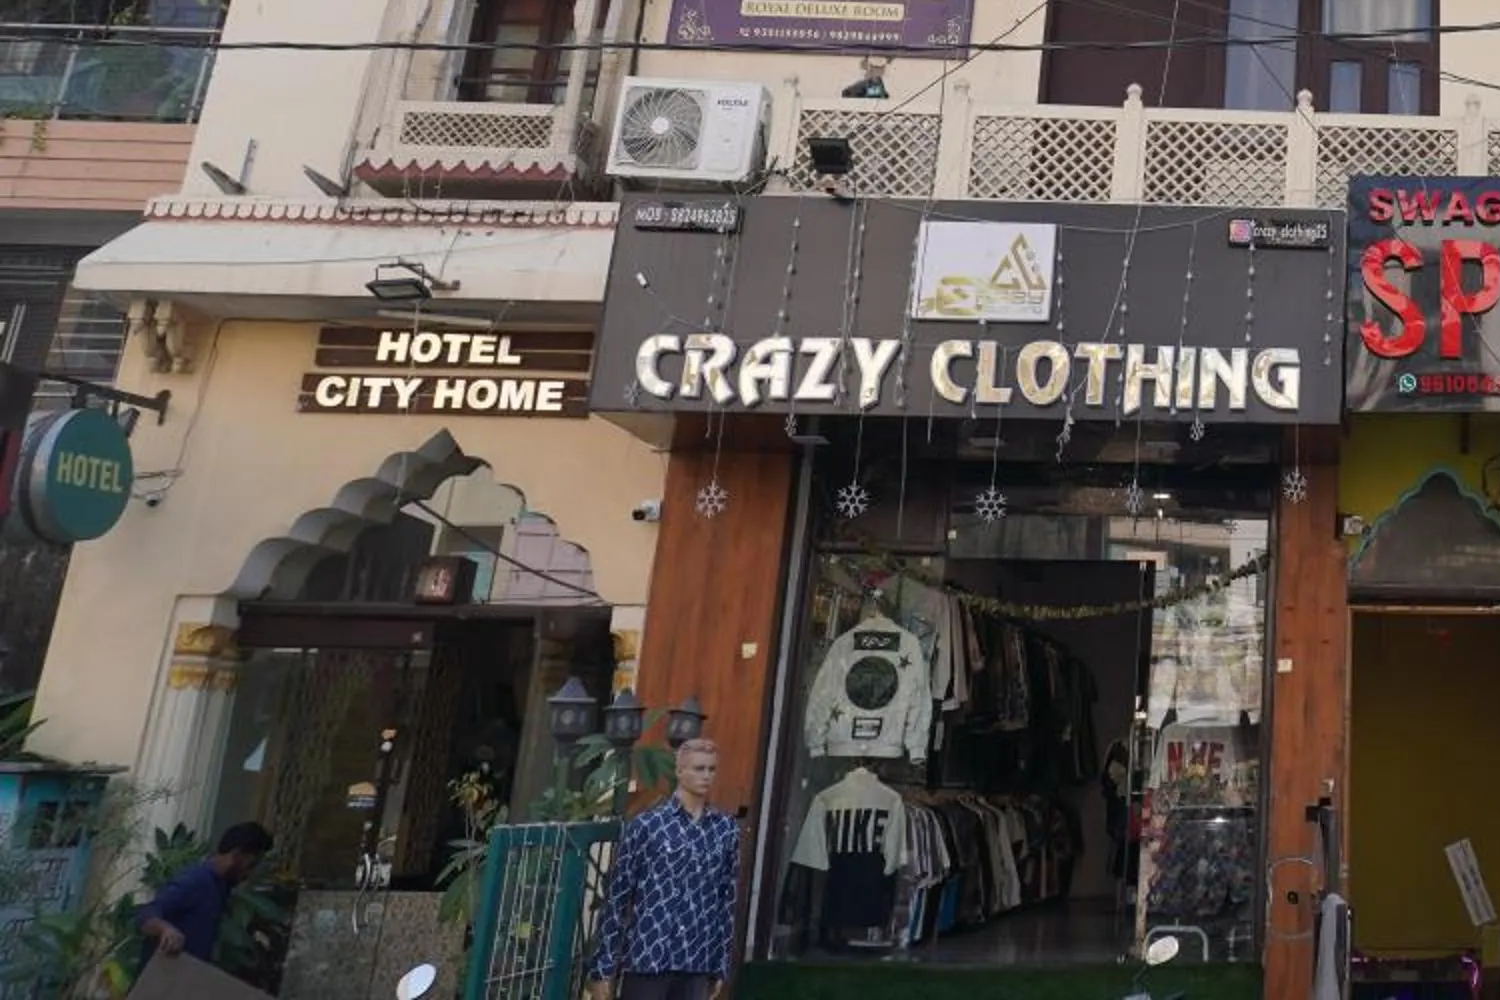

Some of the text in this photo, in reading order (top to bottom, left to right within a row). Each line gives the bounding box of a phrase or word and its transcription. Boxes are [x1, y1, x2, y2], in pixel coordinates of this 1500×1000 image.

[745, 0, 900, 18] ROYAL DELUXE ROOM
[376, 331, 522, 366] HOTEL
[315, 376, 565, 412] CITY HOME
[635, 332, 1301, 415] CRAZY CLOTHING
[55, 449, 124, 495] HOTEL
[825, 807, 889, 853] NIKE
